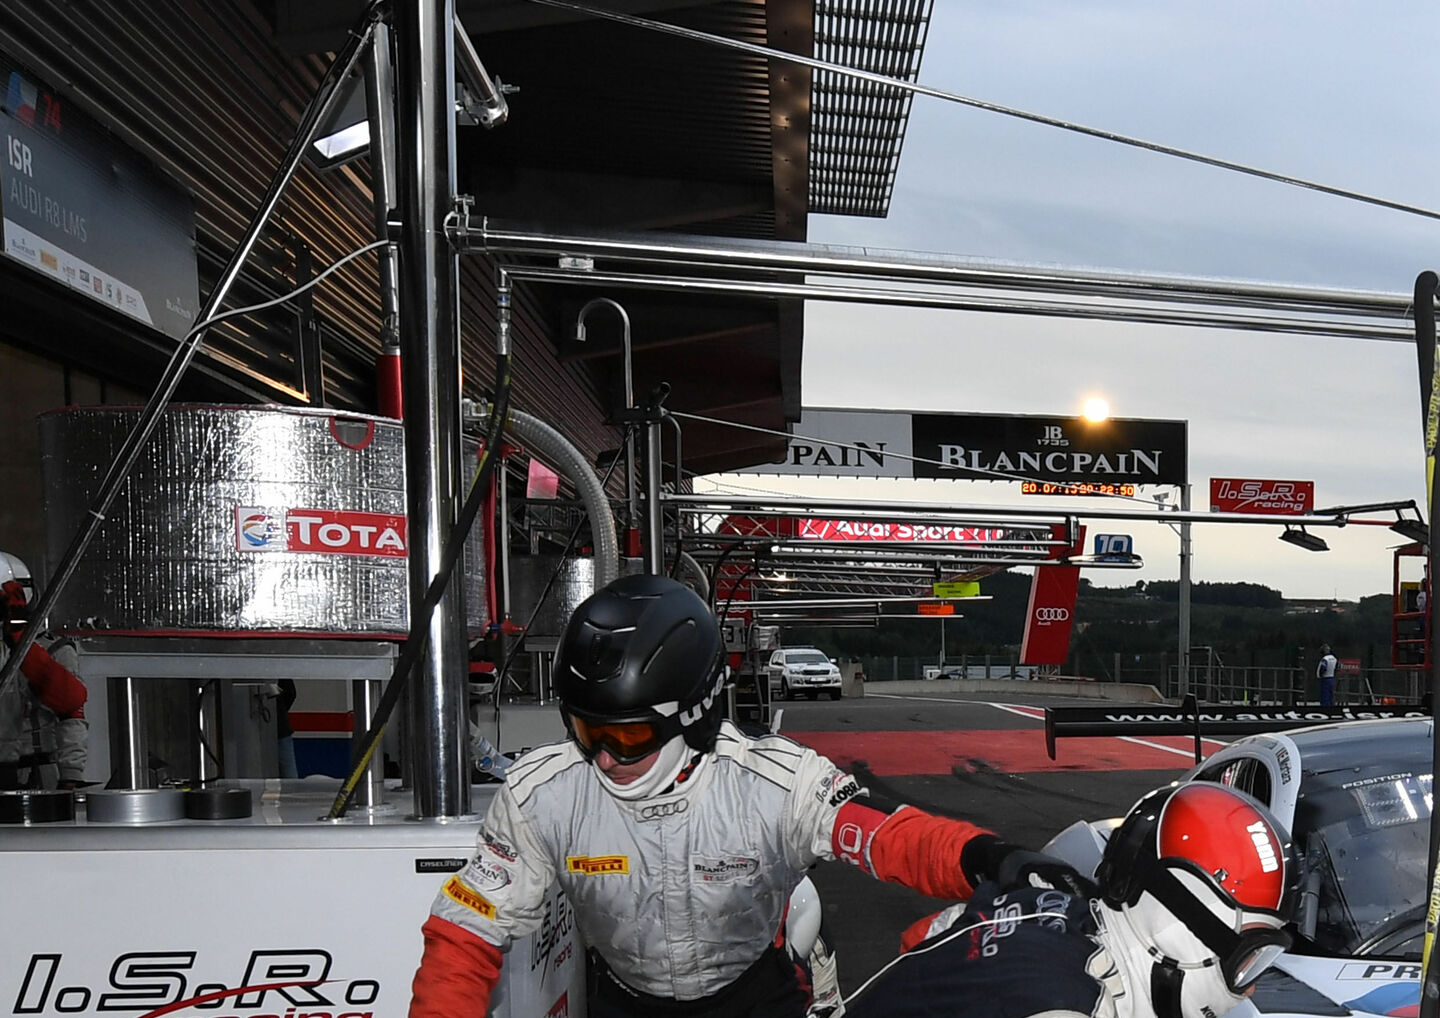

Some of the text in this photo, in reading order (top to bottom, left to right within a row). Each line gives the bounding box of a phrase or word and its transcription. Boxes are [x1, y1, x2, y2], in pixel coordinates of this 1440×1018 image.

[8, 135, 33, 178] ISR
[10, 178, 88, 243] AUDI R8 LMS
[1036, 438, 1070, 447] 1735
[938, 443, 1162, 476] BLANCPAIN
[1253, 500, 1304, 511] racing
[287, 515, 406, 551] TOTA
[1100, 535, 1129, 554] 10
[829, 781, 860, 807] KOBR
[1342, 771, 1413, 790] POSITION
[1246, 820, 1279, 873] Yann
[571, 857, 623, 873] PIRELLI
[12, 949, 380, 1014] I.S.R.
